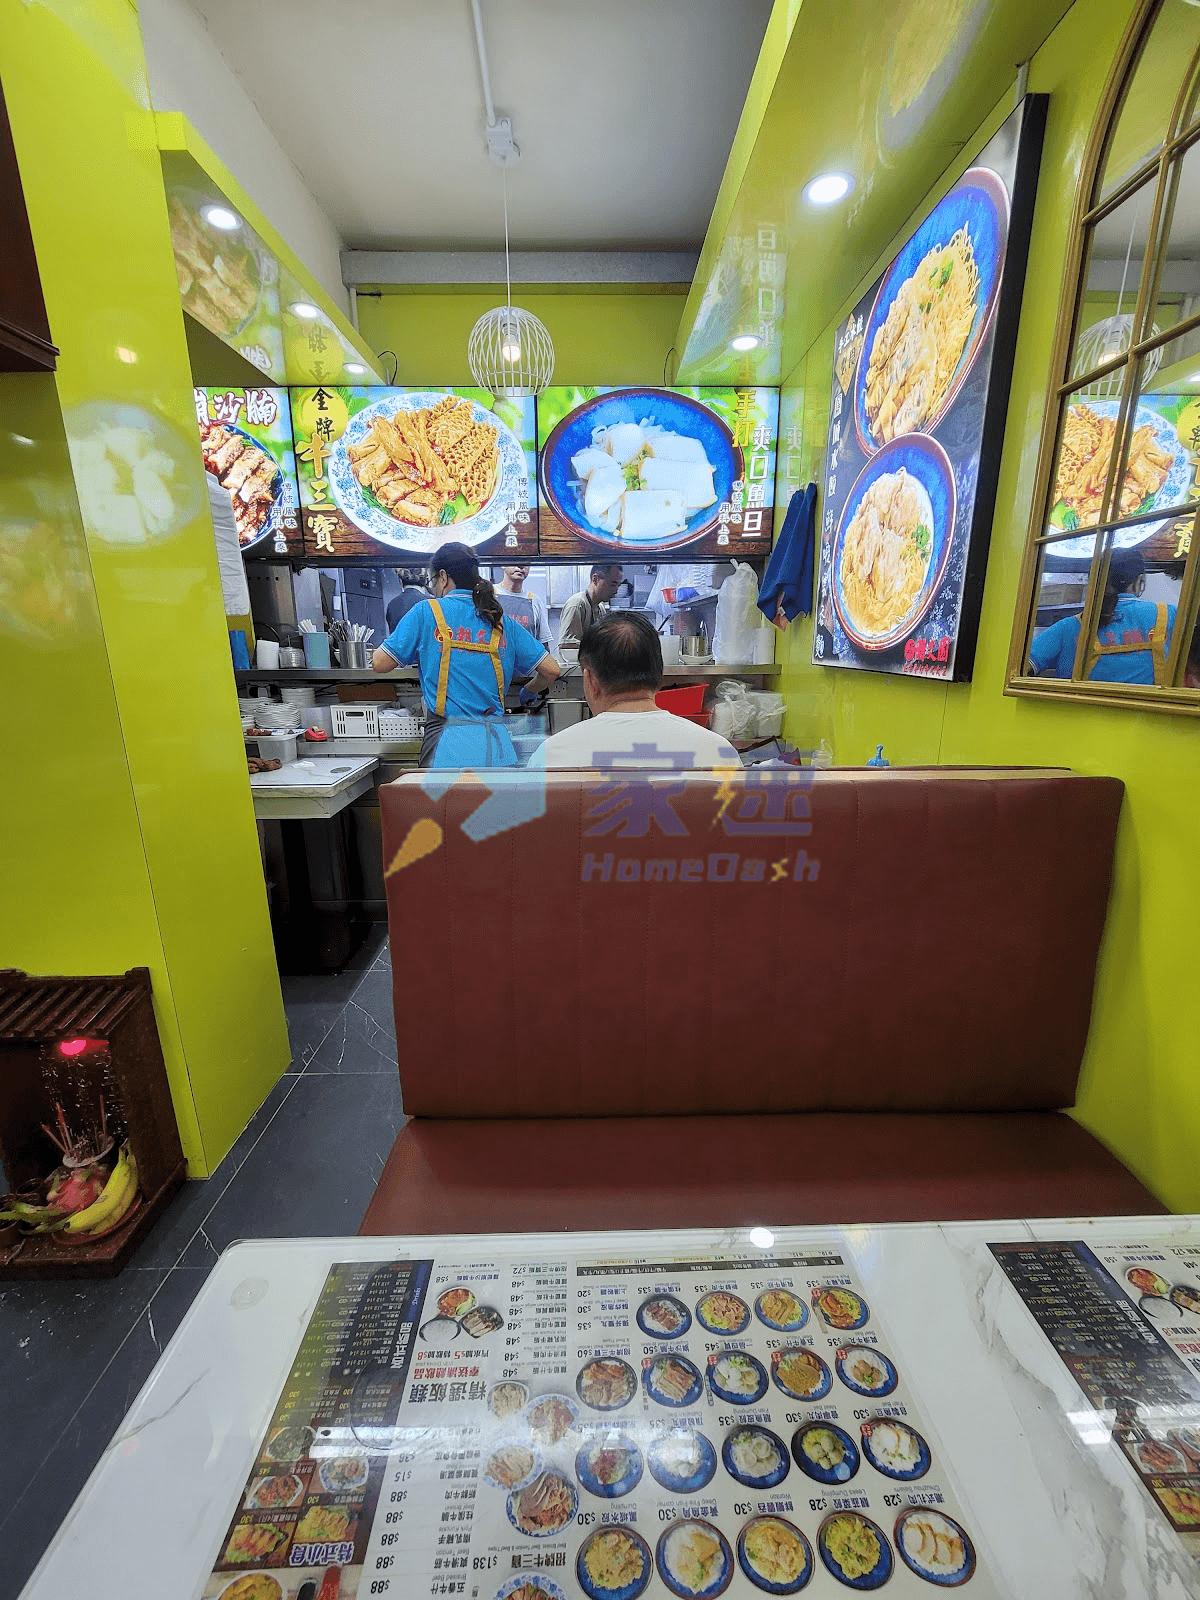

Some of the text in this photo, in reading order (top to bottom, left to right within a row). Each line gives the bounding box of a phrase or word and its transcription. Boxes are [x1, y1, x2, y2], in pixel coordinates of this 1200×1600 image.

[732, 390, 756, 448] 手打
[742, 424, 773, 537] 爽口魚旦
[512, 1266, 526, 1274] $72
[511, 1280, 525, 1288] $48
[694, 1284, 708, 1293] $35
[750, 1281, 764, 1290] $35
[806, 1280, 820, 1288] $35
[577, 1289, 592, 1298] $20
[637, 1286, 652, 1294] $35
[510, 1294, 524, 1302] $48
[508, 1308, 523, 1316] $48
[577, 1304, 592, 1314] $30
[507, 1322, 522, 1330] $48
[577, 1321, 592, 1330] $35
[390, 1322, 413, 1369] 各式飲品
[505, 1336, 520, 1346] $48
[766, 1339, 780, 1348] $35
[826, 1337, 842, 1346] $35
[642, 1345, 658, 1355] $50
[704, 1342, 720, 1352] $45
[504, 1352, 520, 1362] $48
[577, 1348, 592, 1358] $60
[413, 1366, 479, 1380] 奉送凍熱飲品
[502, 1368, 518, 1378] $48
[408, 1380, 486, 1404] 精選飯類
[786, 1412, 802, 1422] $30
[853, 1408, 870, 1419] $30
[718, 1415, 734, 1426] $35
[394, 1470, 412, 1482] $15
[390, 1489, 476, 1502] 新鮮牛肉 $88
[883, 1494, 902, 1506] $28
[610, 1502, 637, 1510] Dumpling
[734, 1502, 752, 1515] $30
[808, 1498, 828, 1510] $28
[385, 1510, 404, 1524] $88
[578, 1510, 638, 1525] 鳳城水餃 $30
[658, 1506, 718, 1520] 黃金魚角 $30
[380, 1532, 471, 1546] 南乳豬手 $88
[289, 1542, 354, 1565] 特式小食
[376, 1555, 468, 1570] 爽滑牛筋 $88
[472, 1552, 566, 1570] 招牌牛三寶 $138
[370, 1580, 466, 1594] 五香牛什 $88
